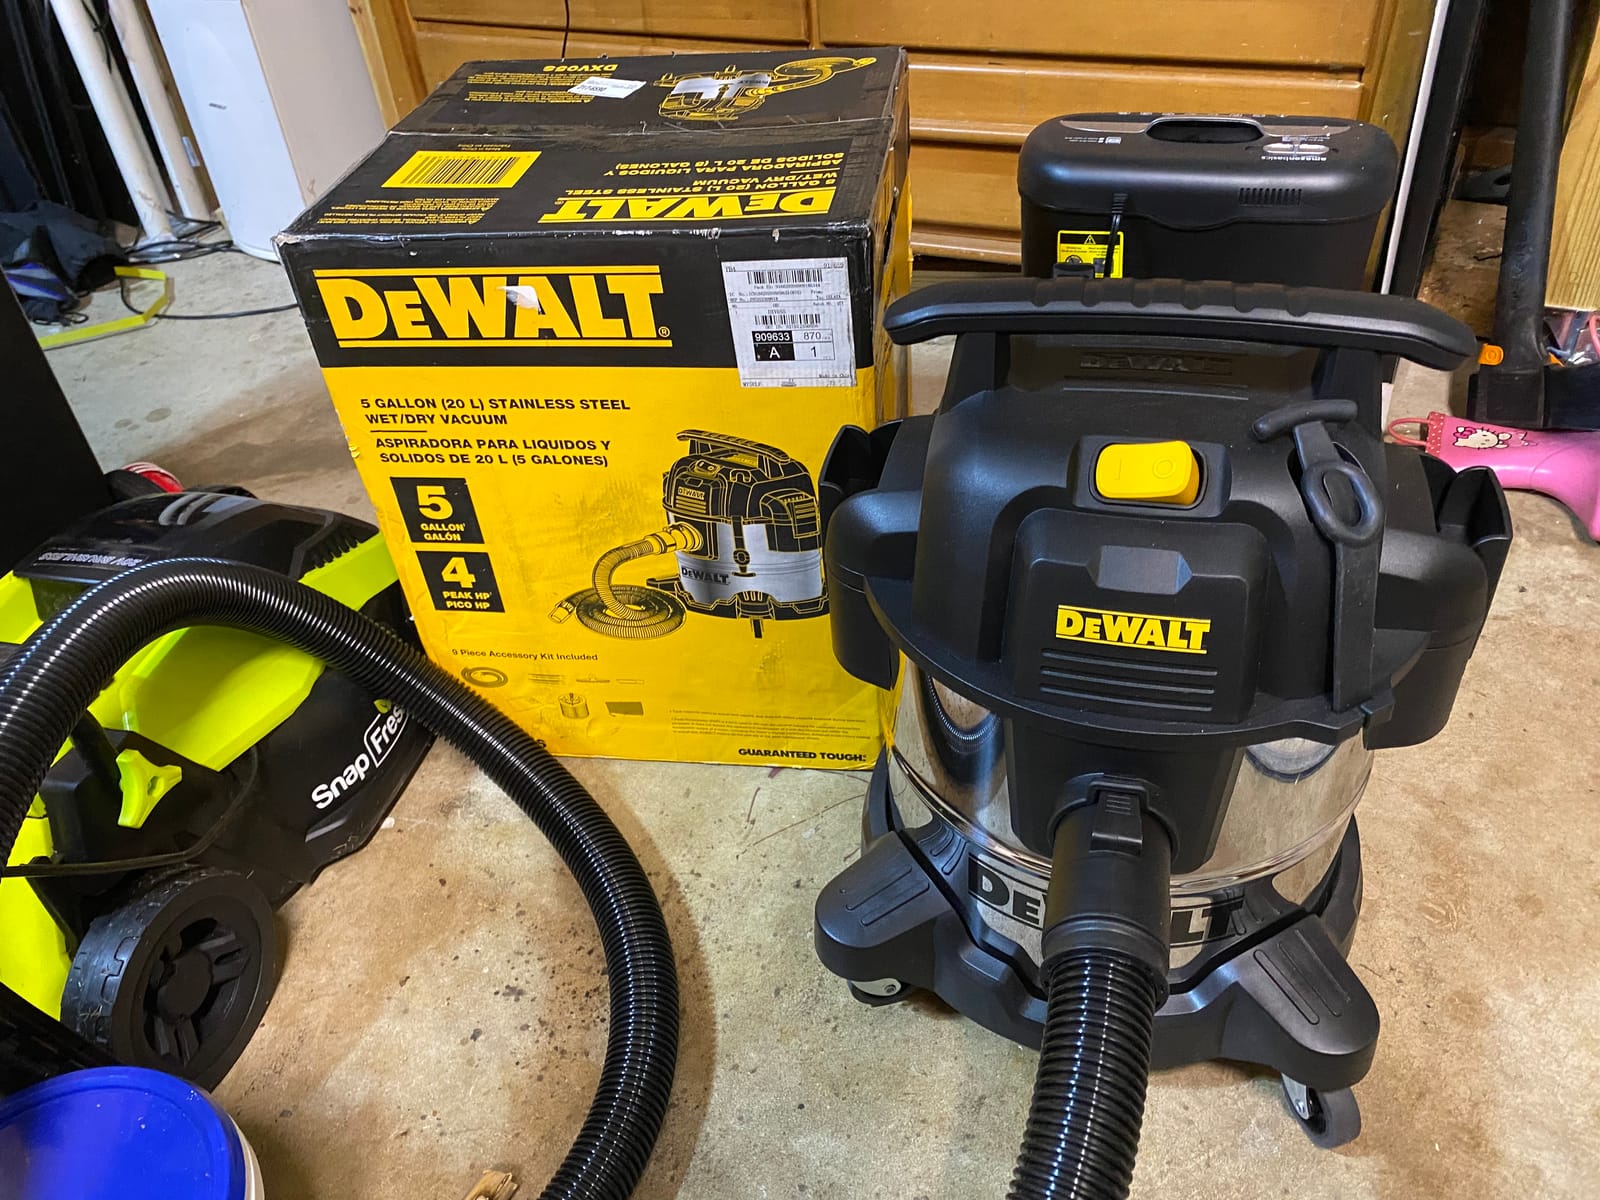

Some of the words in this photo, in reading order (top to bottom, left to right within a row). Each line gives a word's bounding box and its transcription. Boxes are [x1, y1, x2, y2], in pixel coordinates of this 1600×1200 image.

[780, 152, 844, 162] SOLIDOS
[616, 162, 690, 170] GALONES)
[694, 160, 709, 168] (5
[742, 159, 843, 171] ASPIRADORA
[619, 168, 690, 176] LIQUIDOS
[764, 172, 837, 182] WET/DRY
[692, 177, 759, 186] VACUUM
[755, 180, 821, 190] GALLON
[617, 186, 702, 195] STAINLESS
[539, 188, 836, 221] DEWALT
[316, 275, 665, 339] DEWALT
[754, 332, 790, 342] 909633
[803, 332, 821, 341] 870
[769, 346, 781, 359] A
[810, 346, 817, 358] 1
[360, 398, 371, 408] 5
[375, 398, 437, 409] GALLON
[441, 398, 465, 411] (20
[470, 398, 484, 411] L)
[489, 398, 575, 409] STAINLESS
[580, 399, 631, 410] STEEL
[365, 414, 435, 424] WET/DRY
[440, 414, 507, 425] VACUUM
[376, 438, 473, 448] ASPIRADORA
[476, 439, 518, 449] PARA
[522, 440, 597, 450] LIQUIDOS
[600, 440, 611, 450] Y
[380, 453, 445, 463] SOLIDOS
[449, 454, 471, 463] DE
[474, 454, 494, 464] 20
[498, 454, 508, 464] L
[512, 454, 526, 466] (5
[531, 454, 608, 468] GALONES)
[416, 485, 453, 520] 5
[424, 531, 461, 541] GALÓN
[441, 556, 476, 588] 4
[681, 566, 730, 584] DEWALT
[442, 591, 473, 600] PEAK
[446, 601, 472, 609] PICO
[475, 601, 490, 609] HP
[1056, 608, 1211, 650] DEWALT
[460, 649, 487, 657] Piece
[489, 651, 538, 661] Accessory
[540, 652, 554, 660] Kit
[557, 653, 598, 661] Included
[311, 753, 370, 809] Snap
[370, 704, 405, 755] Fres
[738, 748, 817, 760] GUARANTEED
